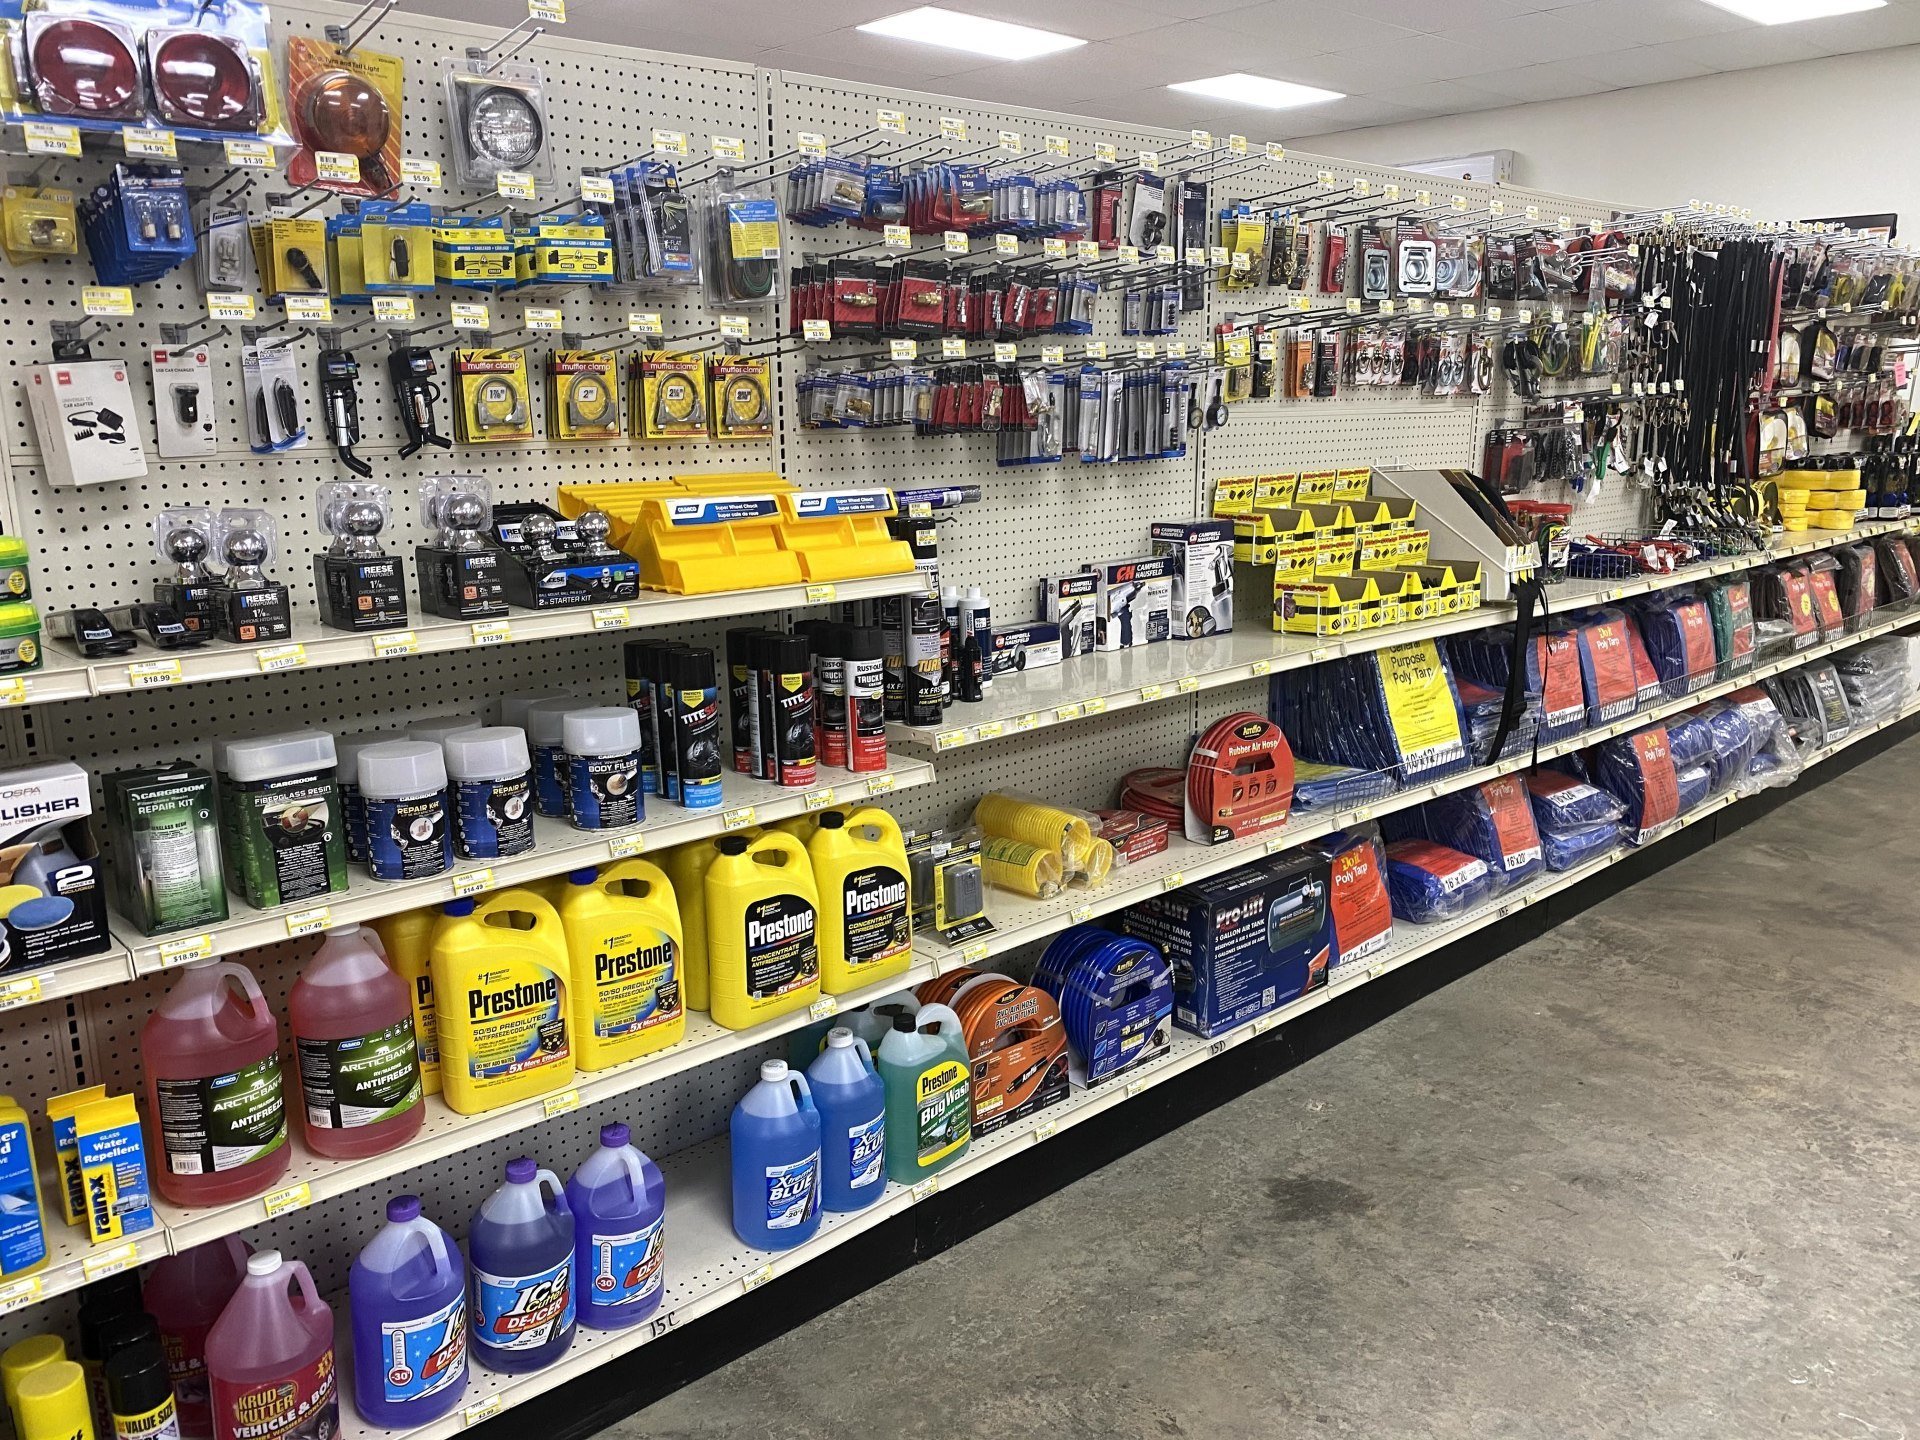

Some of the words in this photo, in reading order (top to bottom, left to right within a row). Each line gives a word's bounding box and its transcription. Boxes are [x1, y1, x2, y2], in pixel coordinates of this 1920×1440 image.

[364, 63, 380, 73] Light
[44, 140, 67, 149] $2.99
[142, 144, 164, 152] $4.99
[219, 309, 243, 317] $11.99
[301, 312, 320, 320] $4.49
[468, 362, 494, 370] muffler
[495, 362, 520, 371] clamp
[562, 362, 586, 370] muffler
[588, 362, 610, 371] clamp
[650, 362, 674, 370] muffler
[676, 362, 698, 371] clamp
[720, 366, 741, 374] muffler
[742, 366, 764, 374] clamp
[714, 504, 728, 512] Super
[1198, 530, 1220, 538] CAMPBELL
[469, 556, 496, 565] REESE
[1137, 561, 1164, 572] CAMPBELL
[363, 564, 394, 576] REESE
[1136, 569, 1162, 578] HAUSFELD
[1070, 580, 1092, 589] CAMPBELL
[246, 592, 278, 602] REESE
[1148, 588, 1168, 596] WRENCH
[247, 600, 279, 608] TOWPOWER
[549, 596, 580, 605] STARTER
[581, 594, 592, 602] KIT
[1004, 638, 1030, 646] HAUSFELD
[1006, 632, 1030, 640] CAMPBELL
[386, 646, 408, 656] $10.99
[1556, 640, 1570, 650] Tarp
[1596, 640, 1608, 650] Poly
[1608, 638, 1620, 648] Tarp
[270, 657, 294, 668] $11.99
[1390, 652, 1426, 668] Purpose
[144, 674, 170, 684] $18.99
[858, 674, 879, 684] TRUCK
[1392, 671, 1412, 686] Poly
[1412, 666, 1432, 680] Tarp
[918, 687, 928, 695] 4X
[1243, 724, 1262, 736] Amflo
[1228, 744, 1252, 757] Rubber
[1252, 742, 1261, 752] Air
[1262, 740, 1278, 750] Hose
[1644, 750, 1656, 762] Poly
[1654, 747, 1666, 758] Tarp
[588, 763, 614, 773] BODY
[614, 759, 638, 771] FILLER
[270, 776, 318, 789] CARGROOM
[140, 784, 205, 800] CARGROOM
[254, 788, 306, 806] FIBERGLASS
[308, 785, 332, 794] RESIN
[492, 784, 520, 796] REPAIR
[1, 797, 80, 820] LISHER
[138, 802, 176, 814] REPAIR
[178, 798, 194, 808] KIT
[396, 804, 428, 815] REPAIR
[14, 814, 52, 826] ORBITAL
[56, 864, 95, 892] 2
[1335, 870, 1354, 886] Poly
[1353, 863, 1368, 876] Tarp
[462, 884, 484, 894] $14.49
[846, 881, 906, 916] Prestone
[1216, 896, 1265, 928] Pro-Lift
[299, 921, 322, 932] $17.49
[848, 912, 894, 930] CONCENTRATE
[1128, 911, 1158, 928] GALLON
[1158, 920, 1171, 932] AIR
[1172, 925, 1191, 938] TANK
[748, 909, 813, 948] Prestone
[1220, 928, 1241, 942] GALLON
[1242, 924, 1250, 934] AIR
[1250, 918, 1265, 931] TANK
[1249, 928, 1266, 940] GALLONS
[604, 936, 614, 950] #1
[1168, 934, 1192, 948] GALLONS
[172, 950, 199, 962] $18.99
[751, 942, 800, 962] CONCENTRATE
[1172, 943, 1180, 952] DE
[1180, 945, 1192, 956] AIRE
[595, 941, 672, 980] Prestone
[1116, 958, 1134, 972] Amflo
[478, 972, 489, 986] #1
[599, 988, 621, 997] 50/50
[622, 975, 664, 992] PREDILUTED
[468, 978, 556, 1018] Prestone
[600, 984, 655, 1002] ANTIFREEZE/COOLANT
[1001, 992, 1015, 1002] Amflo
[996, 1008, 1009, 1019] PVC
[1010, 1004, 1020, 1015] AIR
[1021, 996, 1037, 1009] HOSE
[630, 1022, 644, 1032] 5X
[644, 1018, 658, 1028] More
[658, 1008, 680, 1022] Effective
[994, 1018, 1008, 1029] PVC
[1008, 1014, 1020, 1024] AIR
[1020, 1005, 1039, 1020] TUYAU
[473, 1027, 498, 1036] 50/50
[500, 1013, 546, 1032] PREDILUTED
[1134, 1018, 1150, 1032] Amflo
[474, 1024, 537, 1042] ANTIFREEZE/COOLANT
[340, 1058, 385, 1073] ARCTIC
[385, 1048, 406, 1062] BAN
[509, 1062, 524, 1074] 5X
[524, 1058, 540, 1068] More
[542, 1049, 568, 1063] Effective
[216, 1076, 236, 1086] CAMCO
[356, 1062, 413, 1092] ANTIFREEZE
[922, 1065, 958, 1094] Prestone
[1022, 1066, 1038, 1082] Amflo
[213, 1090, 260, 1112] ARCTIC
[260, 1082, 278, 1097] BAN
[920, 1098, 946, 1127] Bug
[946, 1080, 970, 1107] Wash
[248, 1096, 275, 1113] RV/MARINE
[230, 1096, 284, 1130] ANTIFREEZE
[100, 1132, 120, 1140] GLASS
[92, 1136, 128, 1152] Water
[852, 1134, 884, 1160] BLUE
[84, 1143, 140, 1164] Repellent
[770, 1174, 813, 1200] BLUE
[502, 1265, 569, 1316] Ice
[526, 1286, 564, 1313] Cutter
[506, 1297, 562, 1328] DE-ICER
[650, 1311, 680, 1338] 15C
[238, 1388, 278, 1410] KRUD
[239, 1394, 296, 1425] KUTTER
[125, 1413, 156, 1434] VALUE
[158, 1402, 174, 1424] SIZE
[232, 1408, 296, 1438] VEHICLE
[298, 1401, 310, 1415] &
[272, 1414, 303, 1437] WASHER
